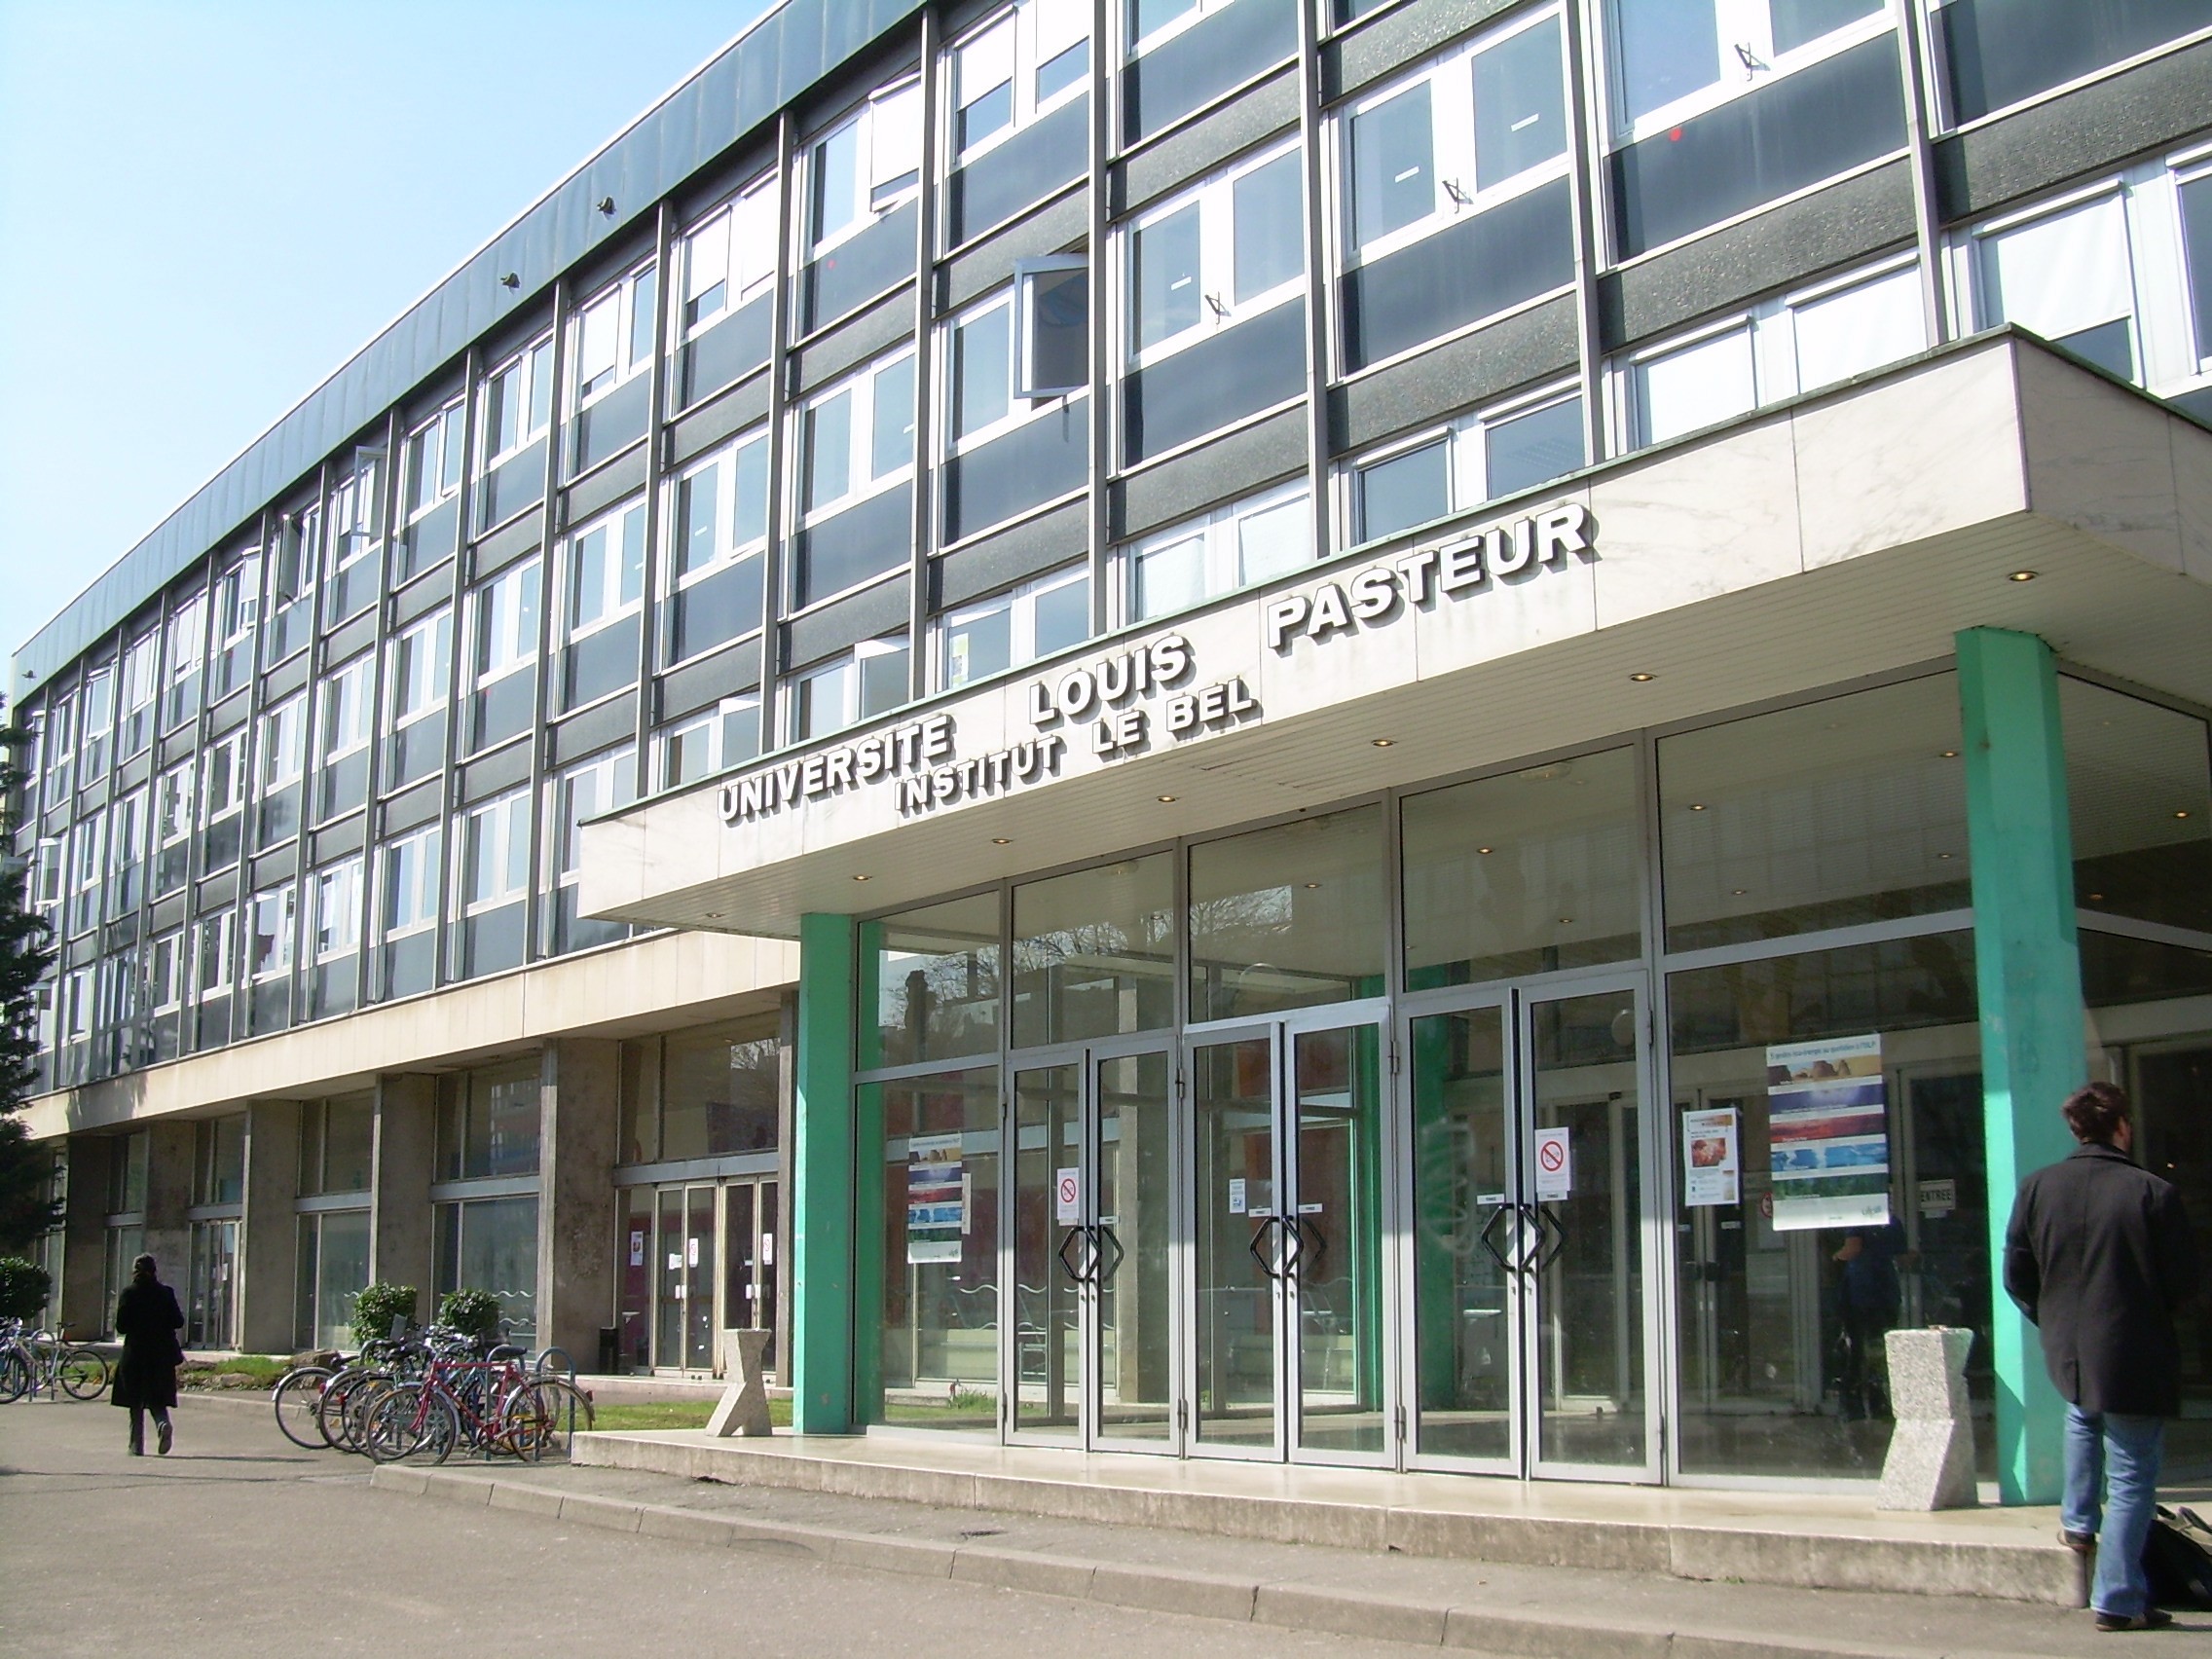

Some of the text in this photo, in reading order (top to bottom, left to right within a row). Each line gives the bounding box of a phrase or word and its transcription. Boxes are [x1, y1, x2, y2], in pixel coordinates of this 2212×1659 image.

[718, 502, 1593, 821] UNIVERSITE LOUIS PASTEUR
[895, 678, 1256, 813] INSTITUT LE BEL
